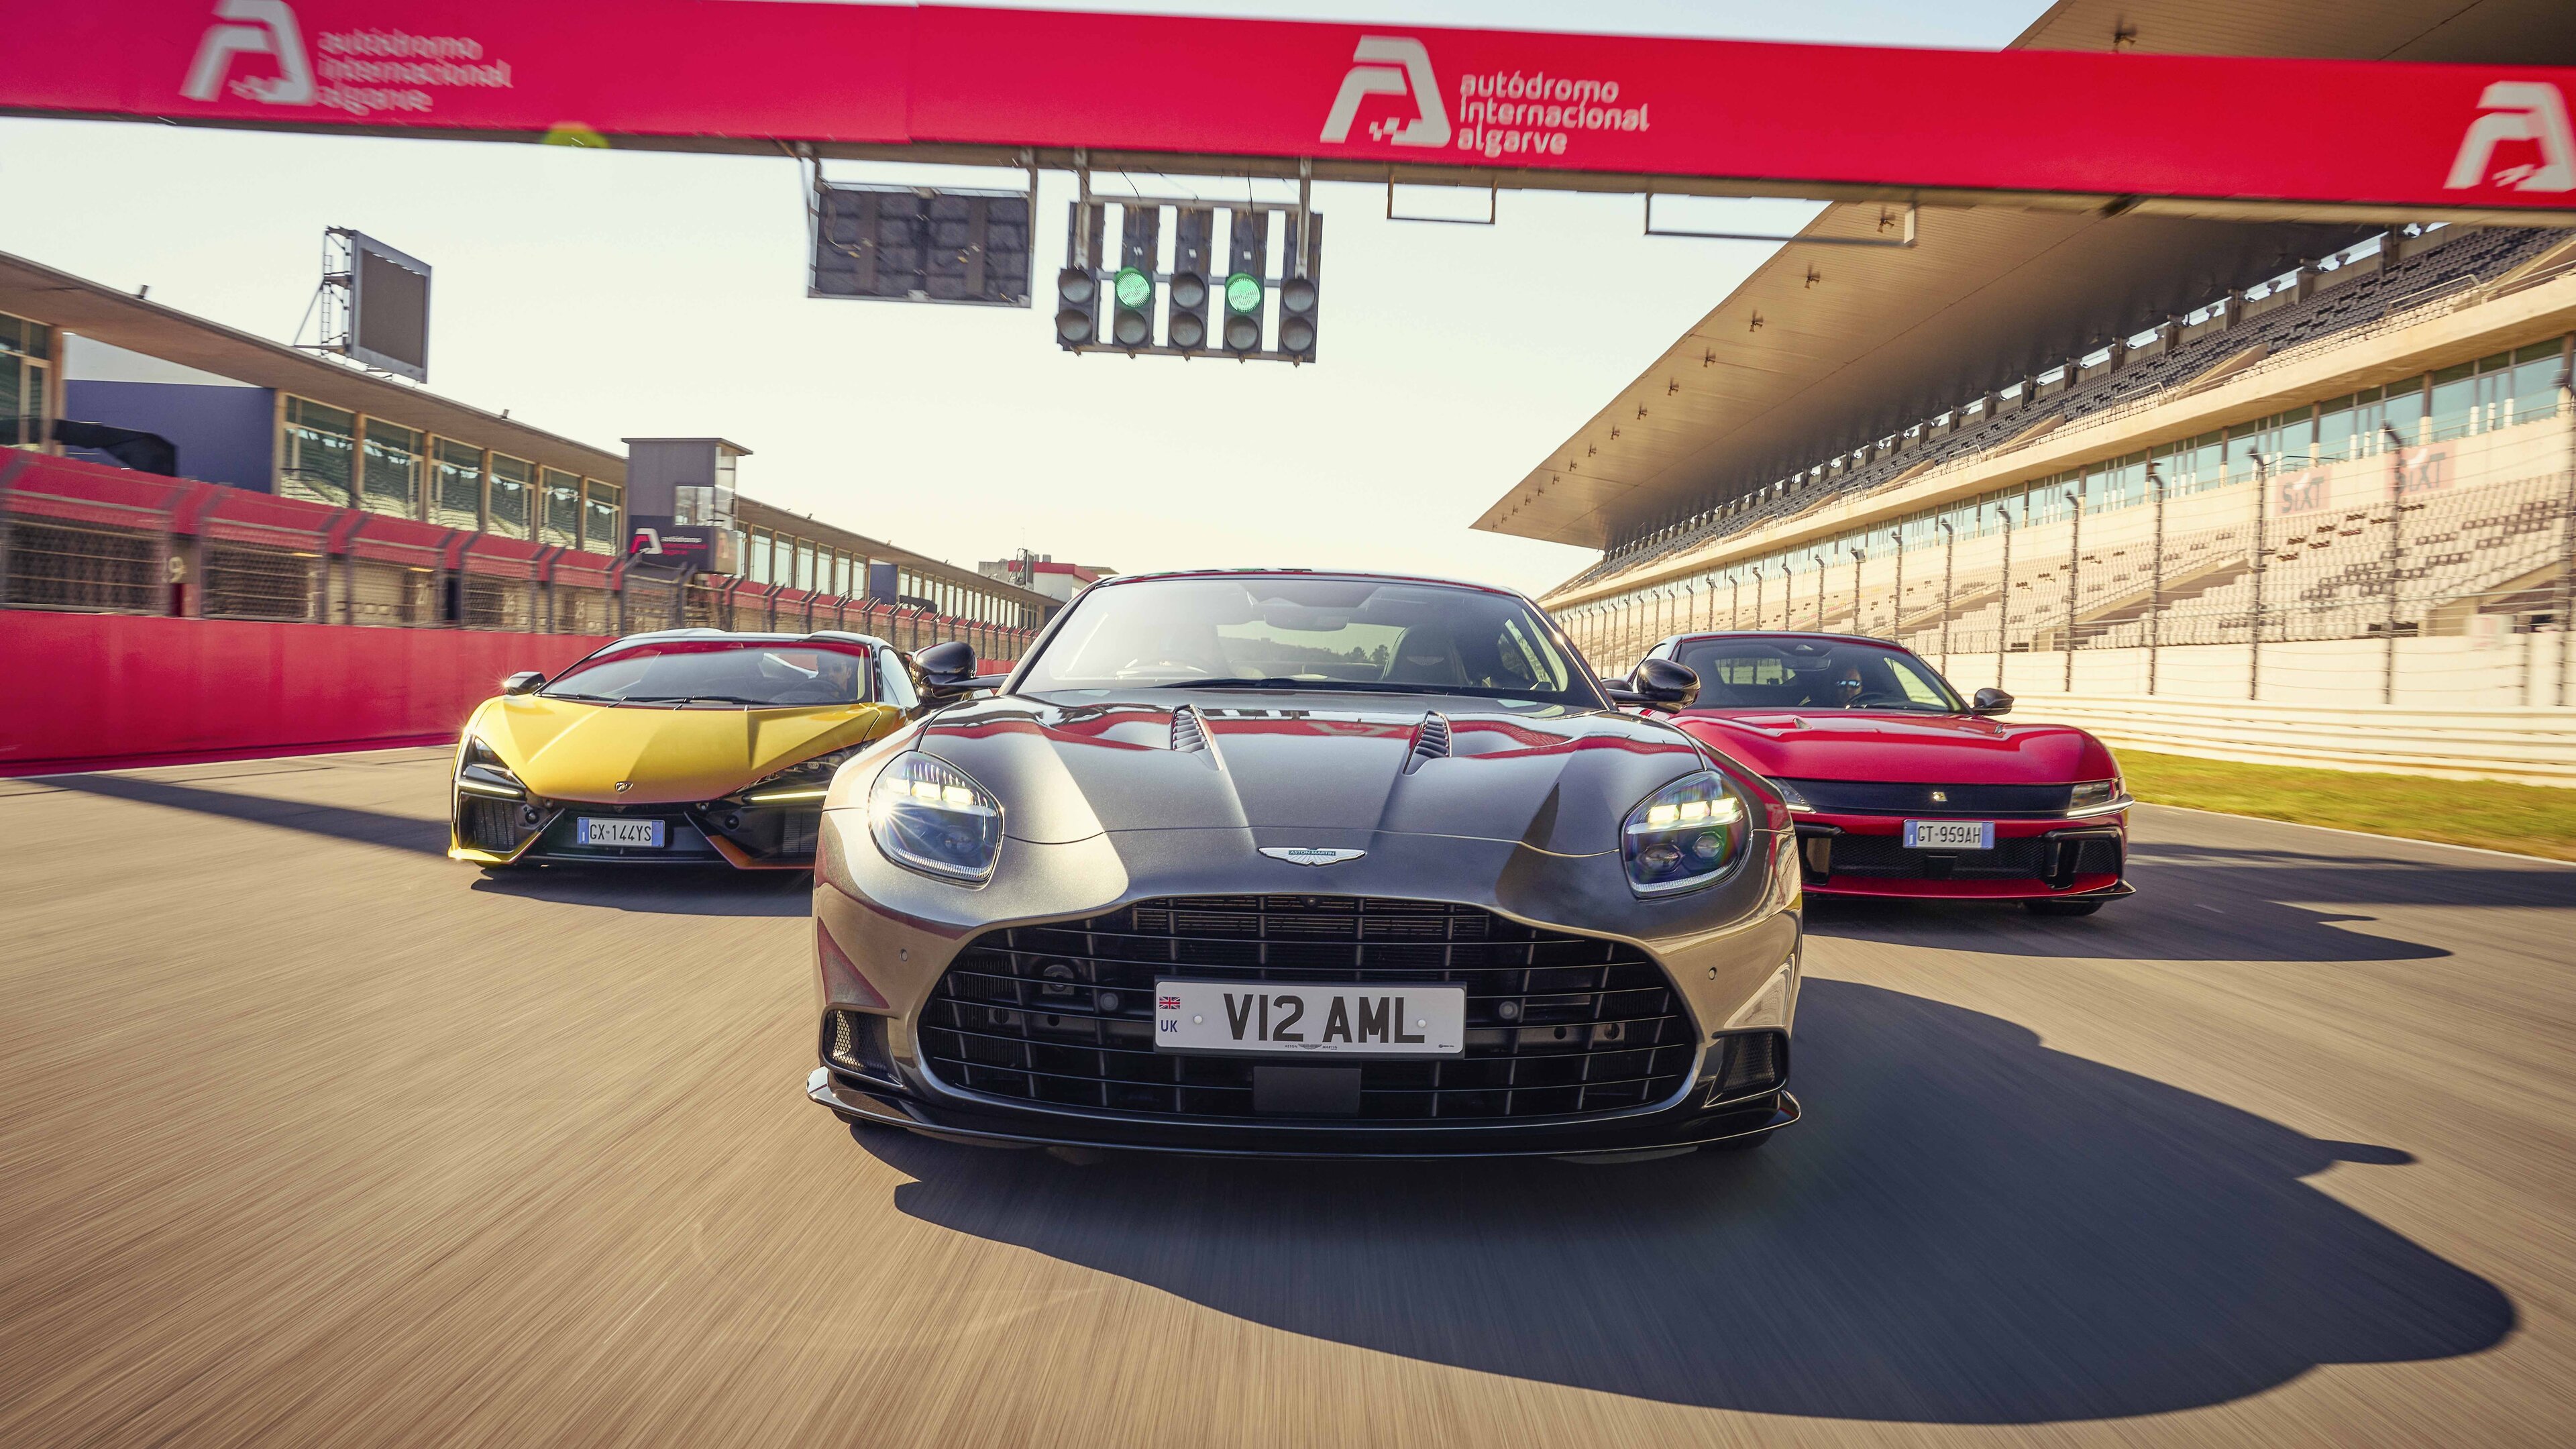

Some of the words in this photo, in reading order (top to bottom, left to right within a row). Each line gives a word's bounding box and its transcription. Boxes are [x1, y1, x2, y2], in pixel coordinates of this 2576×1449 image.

[1460, 71, 1619, 103] autódromo
[1460, 95, 1650, 131] internacional
[1457, 121, 1568, 158] algarve
[1161, 1020, 1178, 1033] UK
[1223, 993, 1305, 1042] V12
[1322, 996, 1426, 1044] AML
